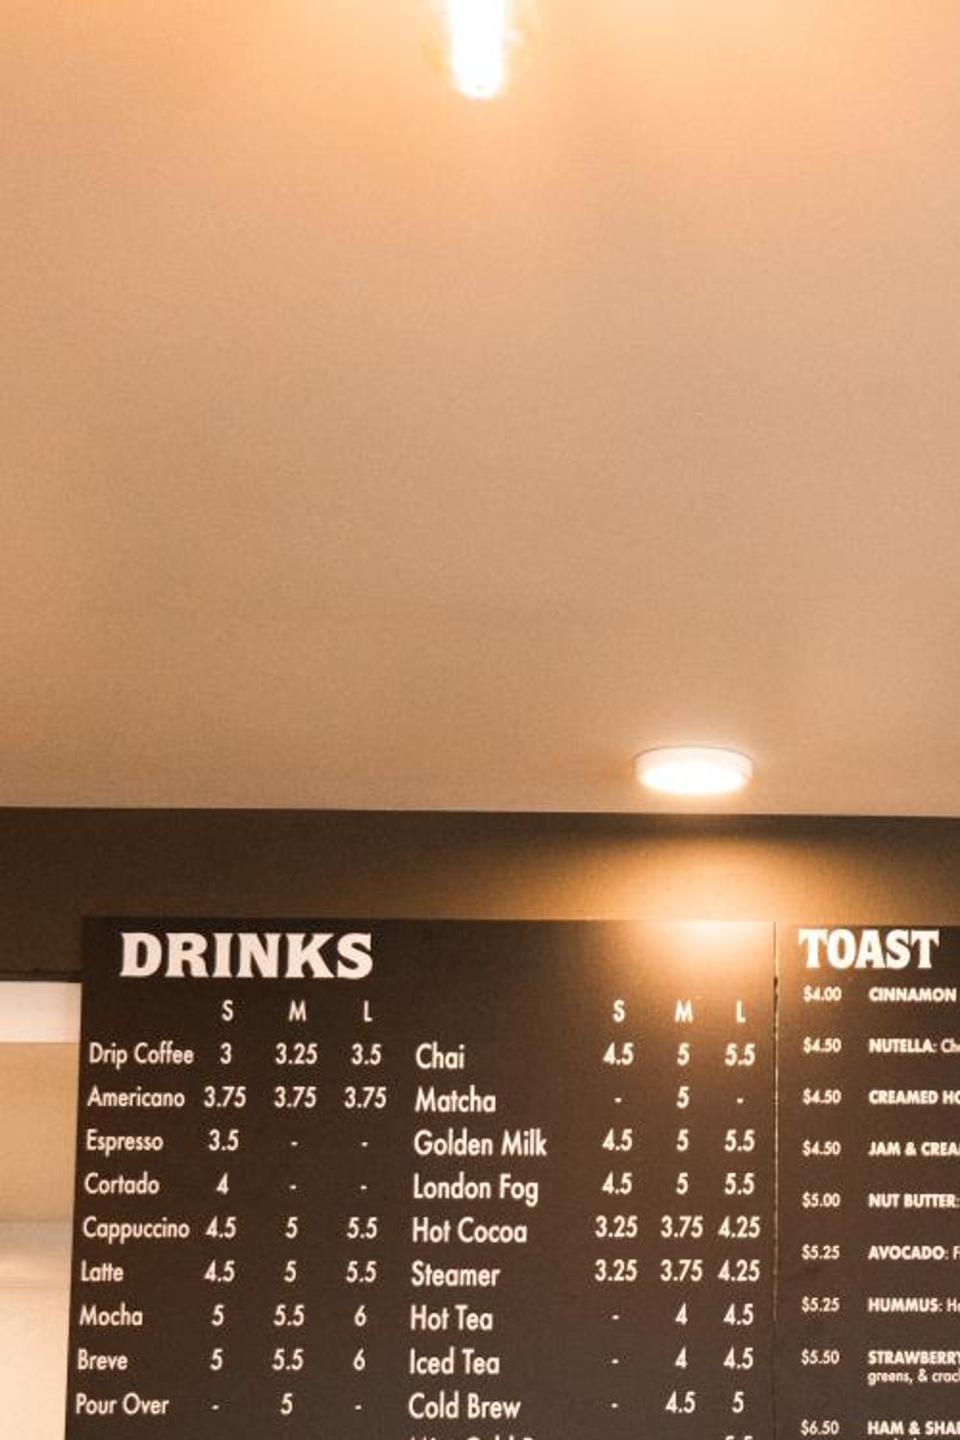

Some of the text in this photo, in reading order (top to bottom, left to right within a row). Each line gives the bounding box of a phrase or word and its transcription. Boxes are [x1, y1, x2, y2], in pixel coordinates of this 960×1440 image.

[120, 933, 373, 979] DRINKS
[799, 929, 939, 969] TOAST
[804, 985, 842, 1002] $4.00
[869, 987, 956, 1002] CINNAMON
[222, 1000, 372, 1022] S M L
[613, 999, 746, 1022] S M L
[89, 1040, 381, 1070] Drip Coffee 3 3.25 3.5
[416, 1041, 755, 1069] Chai 4.5 5 5.5
[803, 1036, 841, 1054] $4.50
[87, 1086, 386, 1108] Americano 3.75 3.75 3.75
[415, 1085, 689, 1112] Matcha 5
[803, 1088, 841, 1105] $4.50
[869, 1090, 939, 1104] CREAMED
[86, 1129, 239, 1156] Espresso 3.5
[414, 1127, 755, 1156] Golden Milk 4.5 5 5.5
[802, 1140, 841, 1156] $4.50
[84, 1171, 229, 1195] Cortado 4
[414, 1171, 754, 1207] London Fog 4.5 5 5.5
[802, 1192, 841, 1208] $5.00
[869, 1193, 900, 1208] NUT
[904, 1193, 960, 1208] BUTTER:
[83, 1216, 377, 1244] Cappuccino 4.5 5 5.5
[413, 1215, 760, 1243] Hot Cocoa 3.25 3.75 4.25
[802, 1244, 839, 1260] $5.25
[81, 1260, 376, 1283] Latte 4.5 5 5.5
[411, 1259, 760, 1287] Steamer 3.25 3.75 4.25
[79, 1302, 366, 1326] Mocha 5 5.5 6
[802, 1296, 840, 1313] $5.25
[411, 1303, 753, 1331] Hot Tea 4 4.5
[78, 1348, 365, 1371] Breve 5 5.5 6
[410, 1346, 753, 1375] Iced Tea 4 4.5
[801, 1349, 839, 1365] $5.50
[76, 1392, 292, 1415] Pour Over 5
[409, 1390, 744, 1419] Cold Brew 4.5 5
[801, 1419, 839, 1436] $6.50
